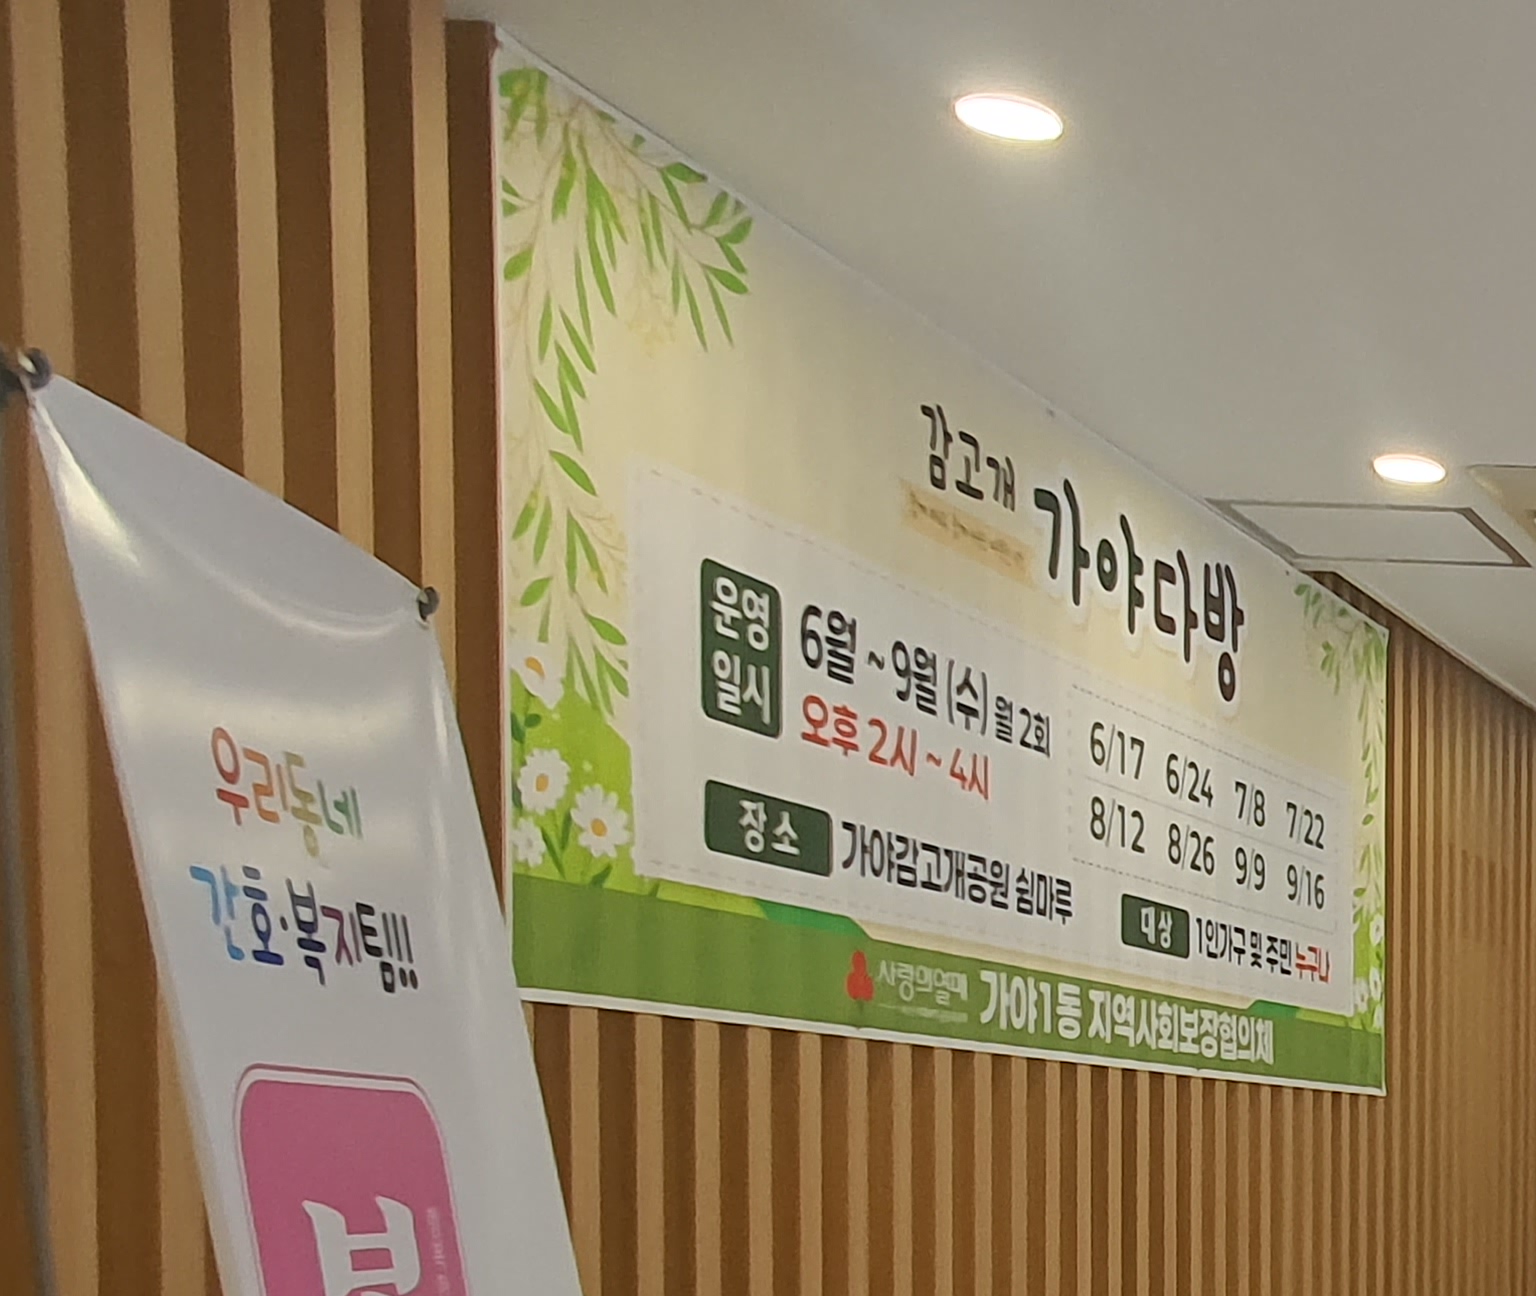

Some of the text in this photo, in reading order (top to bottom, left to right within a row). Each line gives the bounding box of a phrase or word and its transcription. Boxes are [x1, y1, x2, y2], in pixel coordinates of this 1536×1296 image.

[920, 404, 1016, 512] 감고개
[710, 576, 770, 652] 운영
[1034, 477, 1245, 702] 가야다방
[713, 650, 771, 726] 일시
[801, 604, 857, 686] 6월
[891, 640, 938, 718] 9월
[947, 658, 988, 737] (수)
[994, 695, 1014, 745] 월
[1018, 707, 1051, 759] 2회
[211, 726, 364, 859] 우리동네
[801, 694, 860, 757] 오후
[867, 718, 918, 777] 2시
[950, 747, 990, 801] 4시
[1090, 721, 1325, 851] 6/17 6/24 7/8 7/22
[738, 799, 801, 856] 장소
[841, 821, 1074, 926] 가야감고개공원 쉼마루
[1090, 796, 1325, 910] 8/12 8/26 9/9 9/16
[1140, 905, 1174, 950] 대상
[1195, 916, 1332, 985] 1인가구 및 주민 누구나
[877, 959, 969, 1007] 사랑의열매
[979, 968, 1275, 1066] 가야1동 지역사회보장협의체
